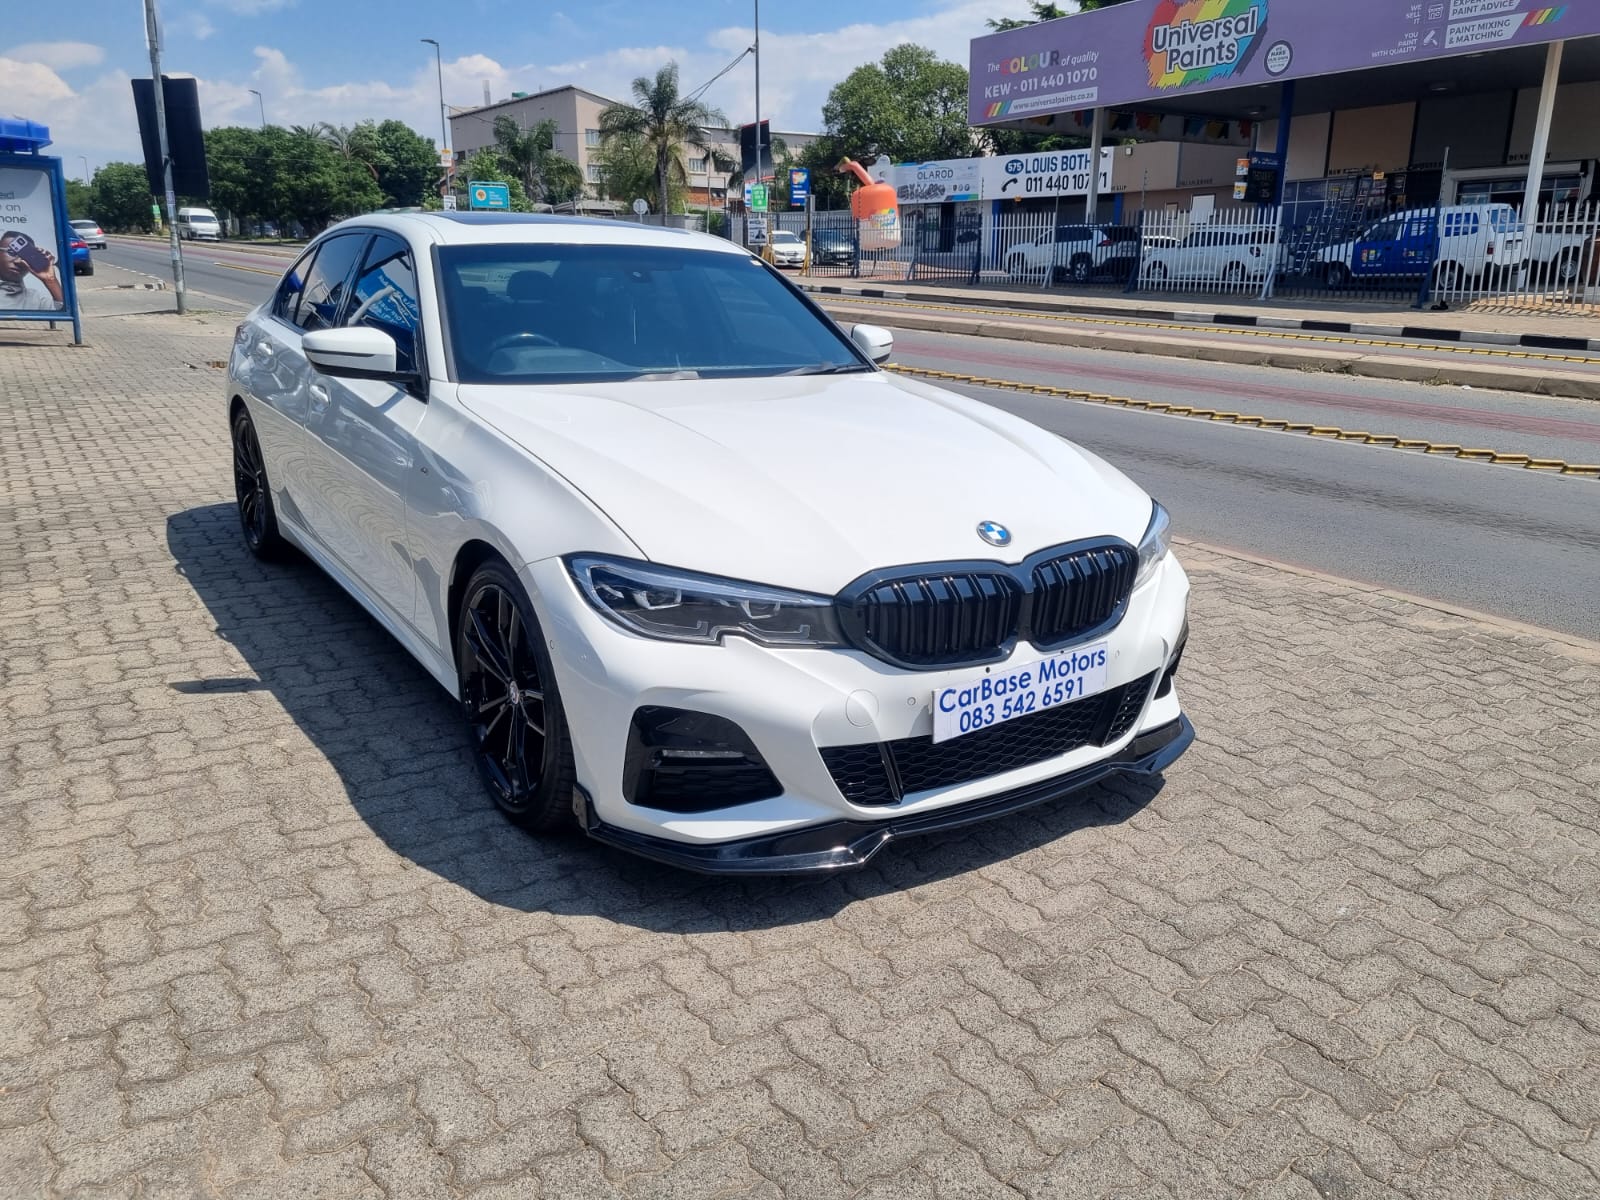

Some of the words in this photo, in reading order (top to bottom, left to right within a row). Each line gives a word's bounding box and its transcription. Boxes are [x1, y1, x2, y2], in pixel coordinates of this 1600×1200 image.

[1453, 5, 1478, 16] PAINT
[1480, 1, 1514, 11] ADVICE
[1153, 8, 1257, 51] Universal
[1449, 24, 1476, 35] PAINT
[1478, 19, 1511, 31] MIXING
[1456, 30, 1504, 43] MATCHING
[1389, 46, 1417, 56] QUALITY
[1398, 39, 1418, 47] PAINT
[987, 62, 1000, 73] The
[1001, 50, 1060, 75] COLOUR
[1061, 55, 1071, 67] of
[1071, 51, 1100, 65] quality
[1167, 40, 1237, 72] Paints
[984, 82, 1012, 99] KEW
[1020, 77, 1038, 92] 011
[1040, 73, 1064, 89] 440
[1066, 67, 1098, 84] 1070
[1013, 92, 1095, 111] www.universalpaints.co.za
[1008, 162, 1021, 171] 575
[1025, 156, 1058, 174] LOUIS
[1025, 176, 1043, 193] 011
[1046, 174, 1069, 191] 440
[939, 671, 1032, 713] CarBase
[1038, 649, 1106, 684] Motors
[959, 703, 995, 733] 083
[1001, 690, 1036, 719] 542
[1042, 676, 1084, 707] 6591
